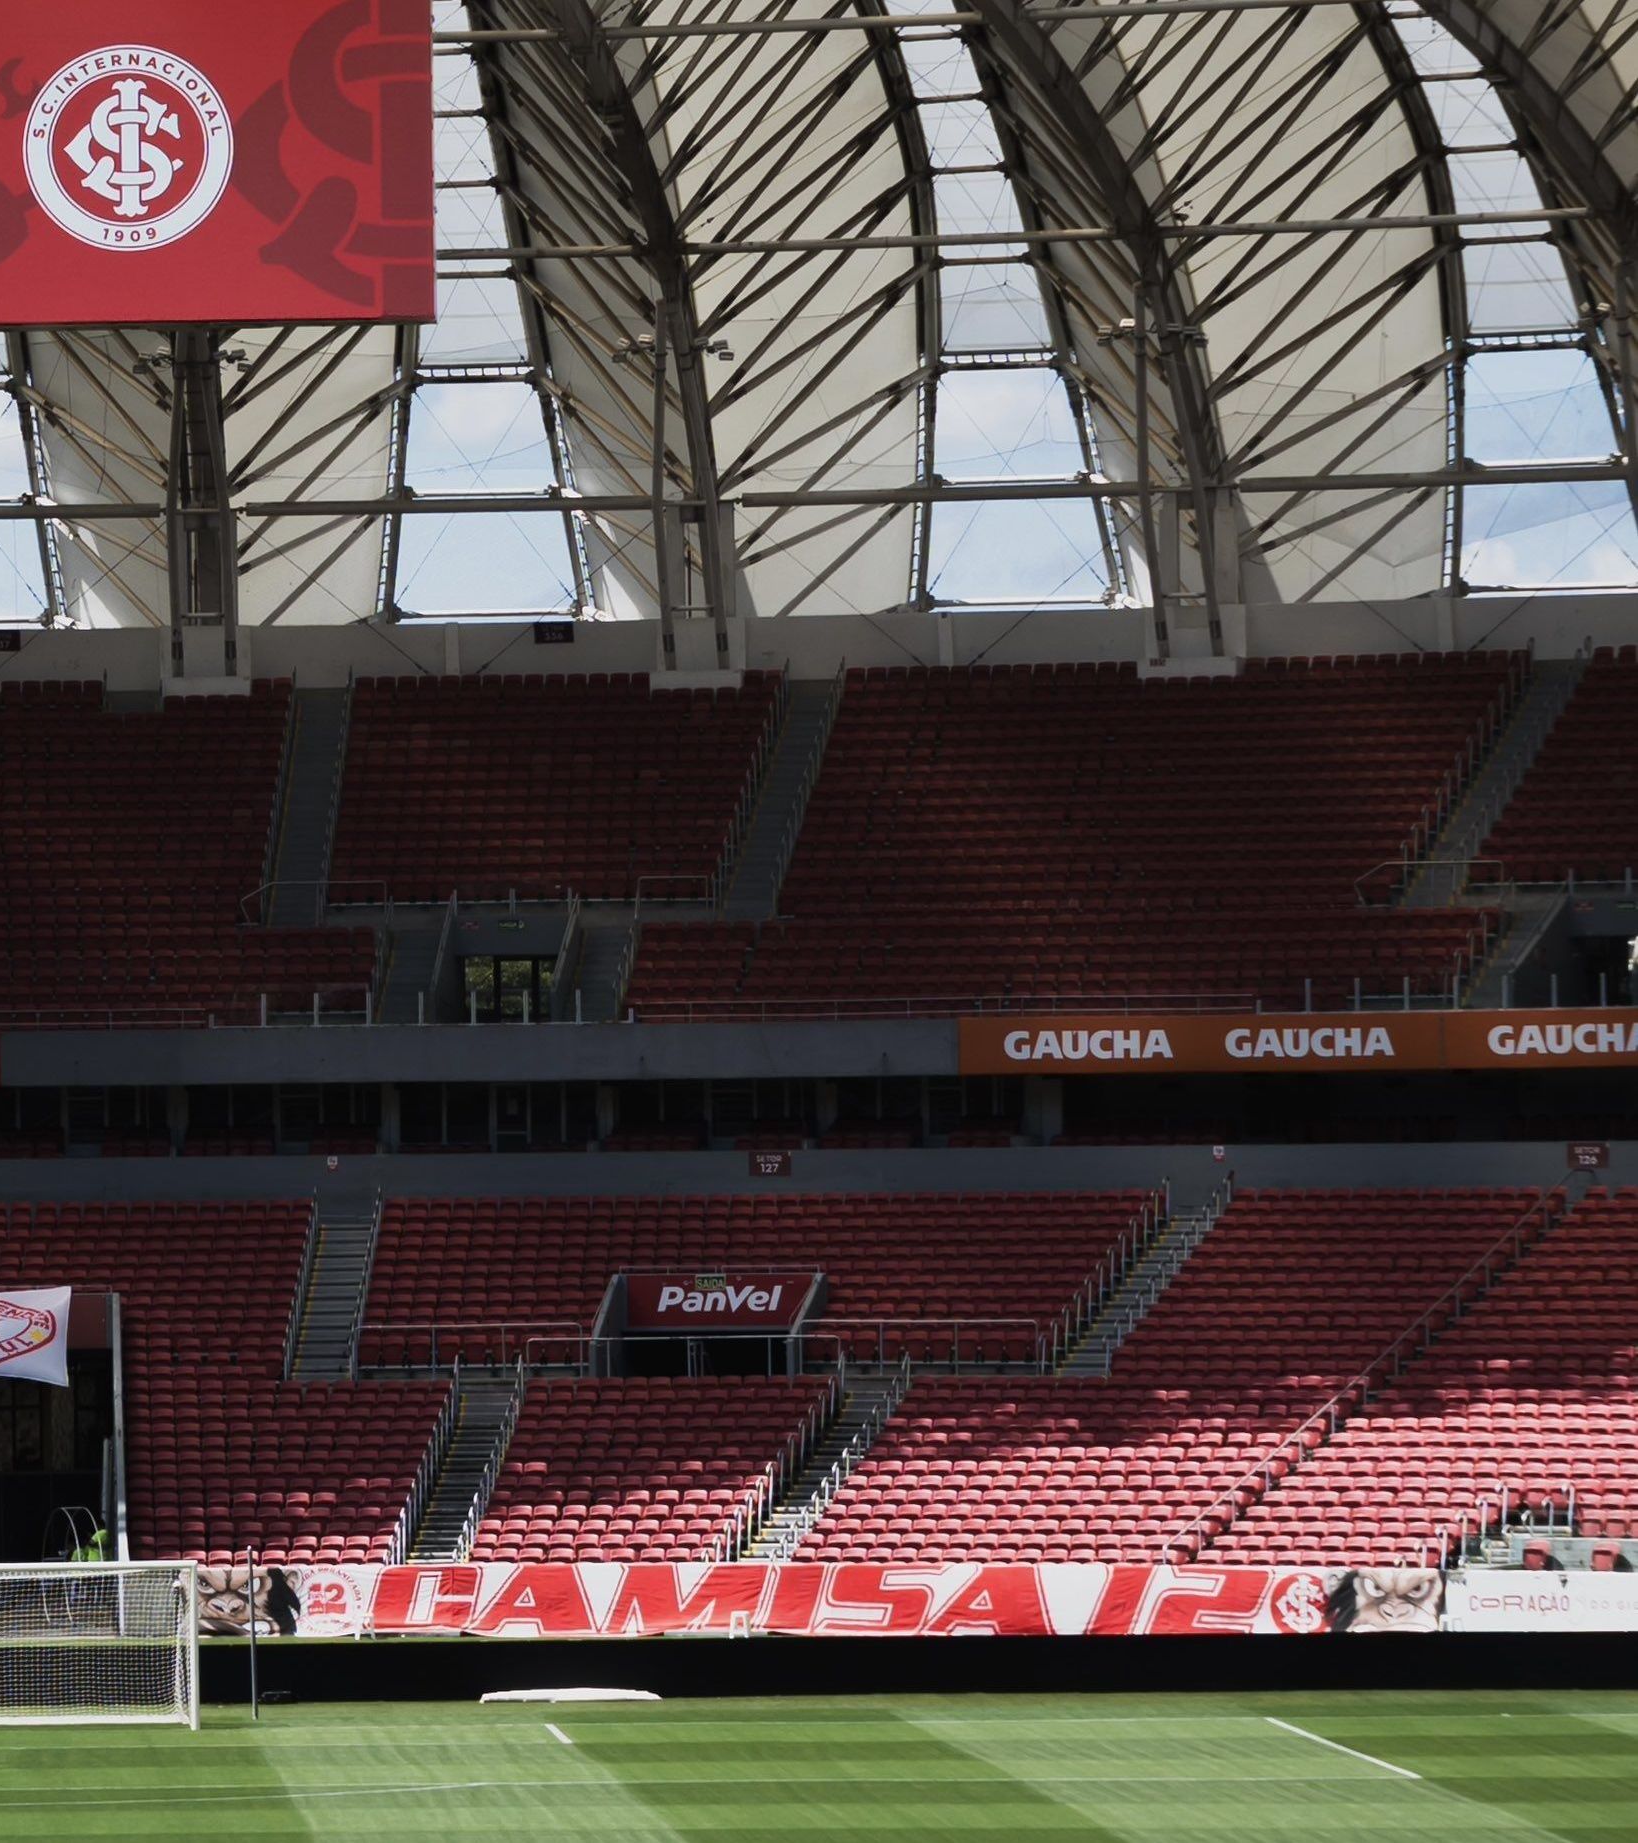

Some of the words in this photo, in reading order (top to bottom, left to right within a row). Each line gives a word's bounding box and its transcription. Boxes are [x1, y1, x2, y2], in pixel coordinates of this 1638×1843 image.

[55, 53, 222, 136] INTERNACIONAL
[102, 227, 157, 242] 1909
[760, 1163, 779, 1173] 127
[658, 1285, 783, 1313] PanVel
[365, 1564, 1057, 1637] CAMISA
